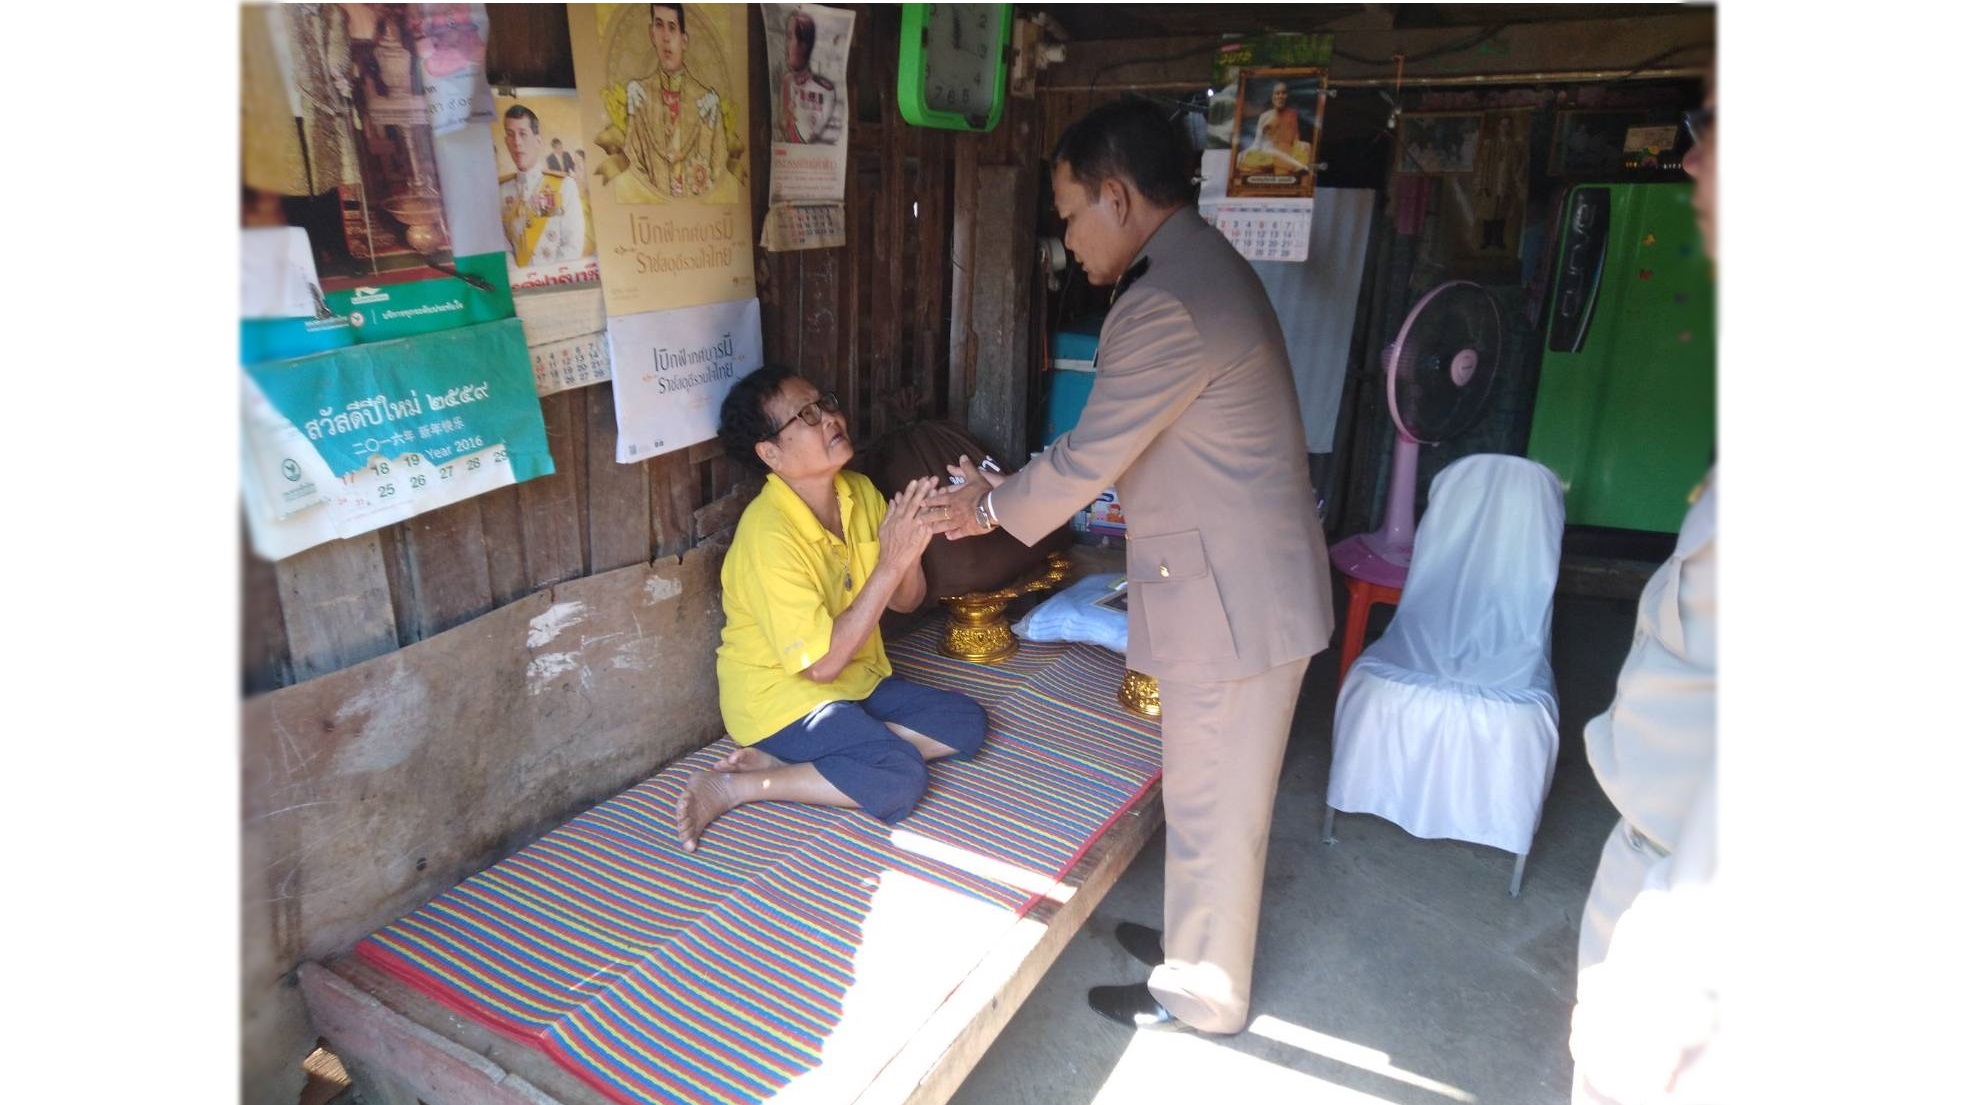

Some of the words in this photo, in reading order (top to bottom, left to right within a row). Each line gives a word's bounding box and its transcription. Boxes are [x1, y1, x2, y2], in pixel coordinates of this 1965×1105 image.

[305, 390, 423, 440] สวัสดีปีใหม่
[426, 382, 490, 411] ๒๕๕๙
[425, 446, 452, 460] Year
[454, 435, 484, 453] 2016
[373, 462, 391, 477] 18
[404, 454, 421, 468] 19
[377, 483, 396, 499] 25
[410, 474, 427, 489] 26
[439, 465, 454, 480] 27
[466, 457, 481, 472] 28
